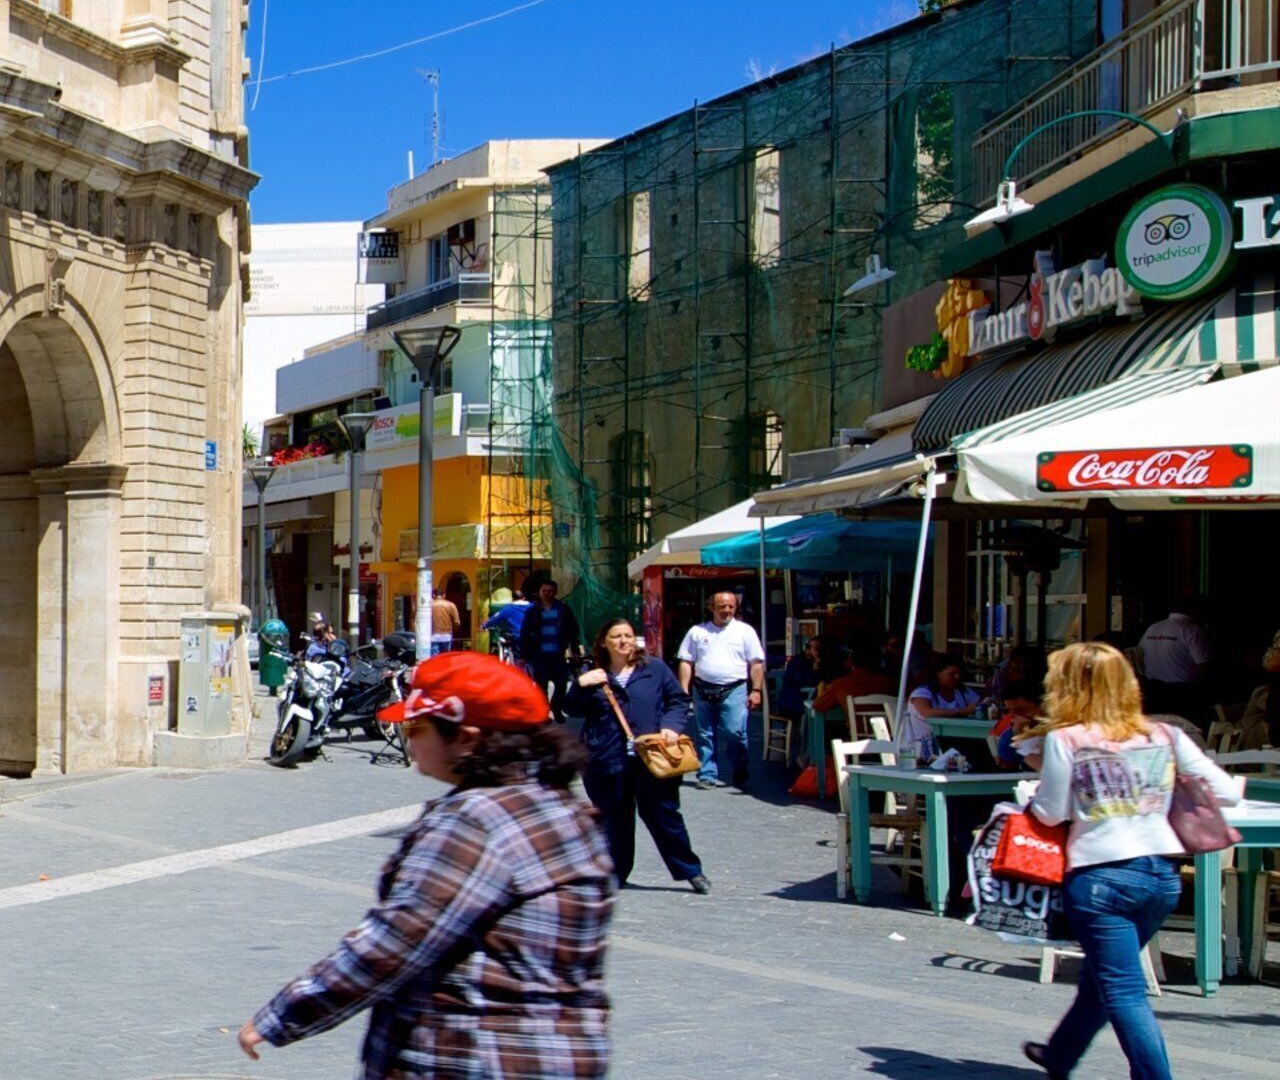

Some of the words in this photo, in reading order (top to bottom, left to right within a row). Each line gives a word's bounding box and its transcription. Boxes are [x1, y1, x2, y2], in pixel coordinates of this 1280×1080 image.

[1132, 243, 1203, 267] tripadvisor
[1046, 259, 1132, 327] Kebap
[1067, 448, 1216, 488] Coca-Cola
[979, 876, 1064, 920] suga
